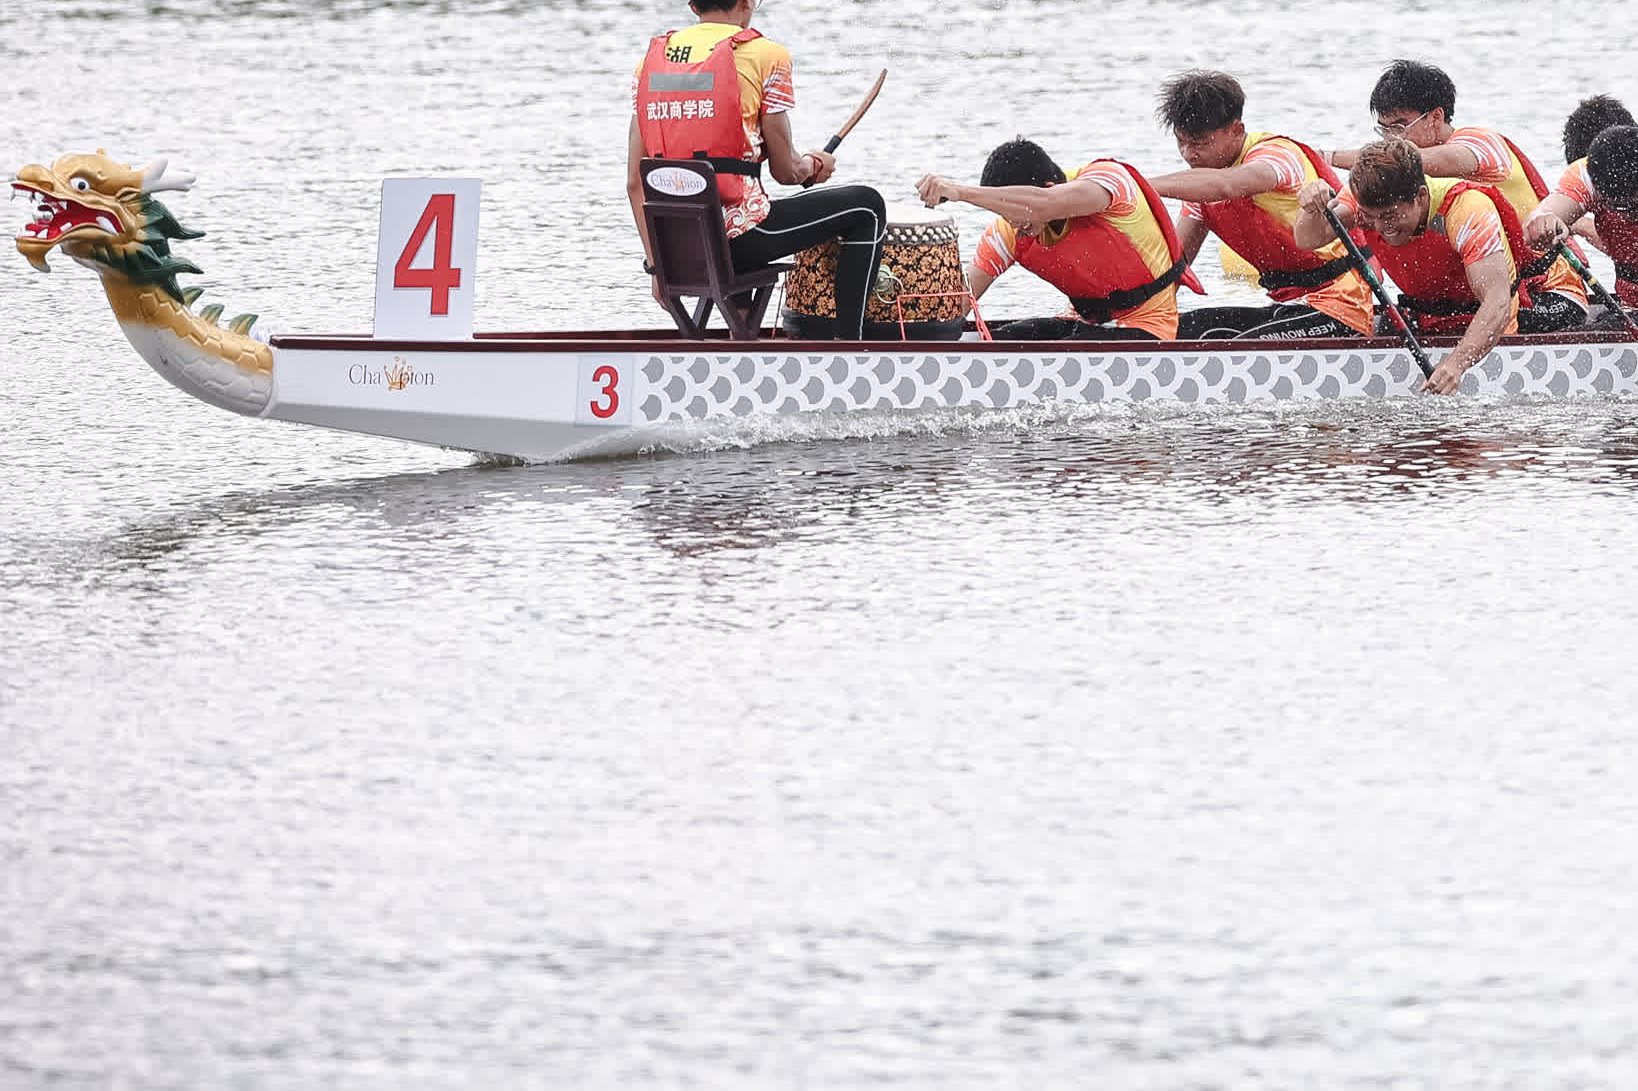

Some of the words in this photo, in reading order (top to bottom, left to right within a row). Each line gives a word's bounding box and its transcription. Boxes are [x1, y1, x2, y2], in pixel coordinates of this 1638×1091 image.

[646, 98, 714, 121] 武汉商学院
[393, 194, 461, 316] 4
[1307, 321, 1337, 337] KEEP
[590, 365, 620, 419] 3
